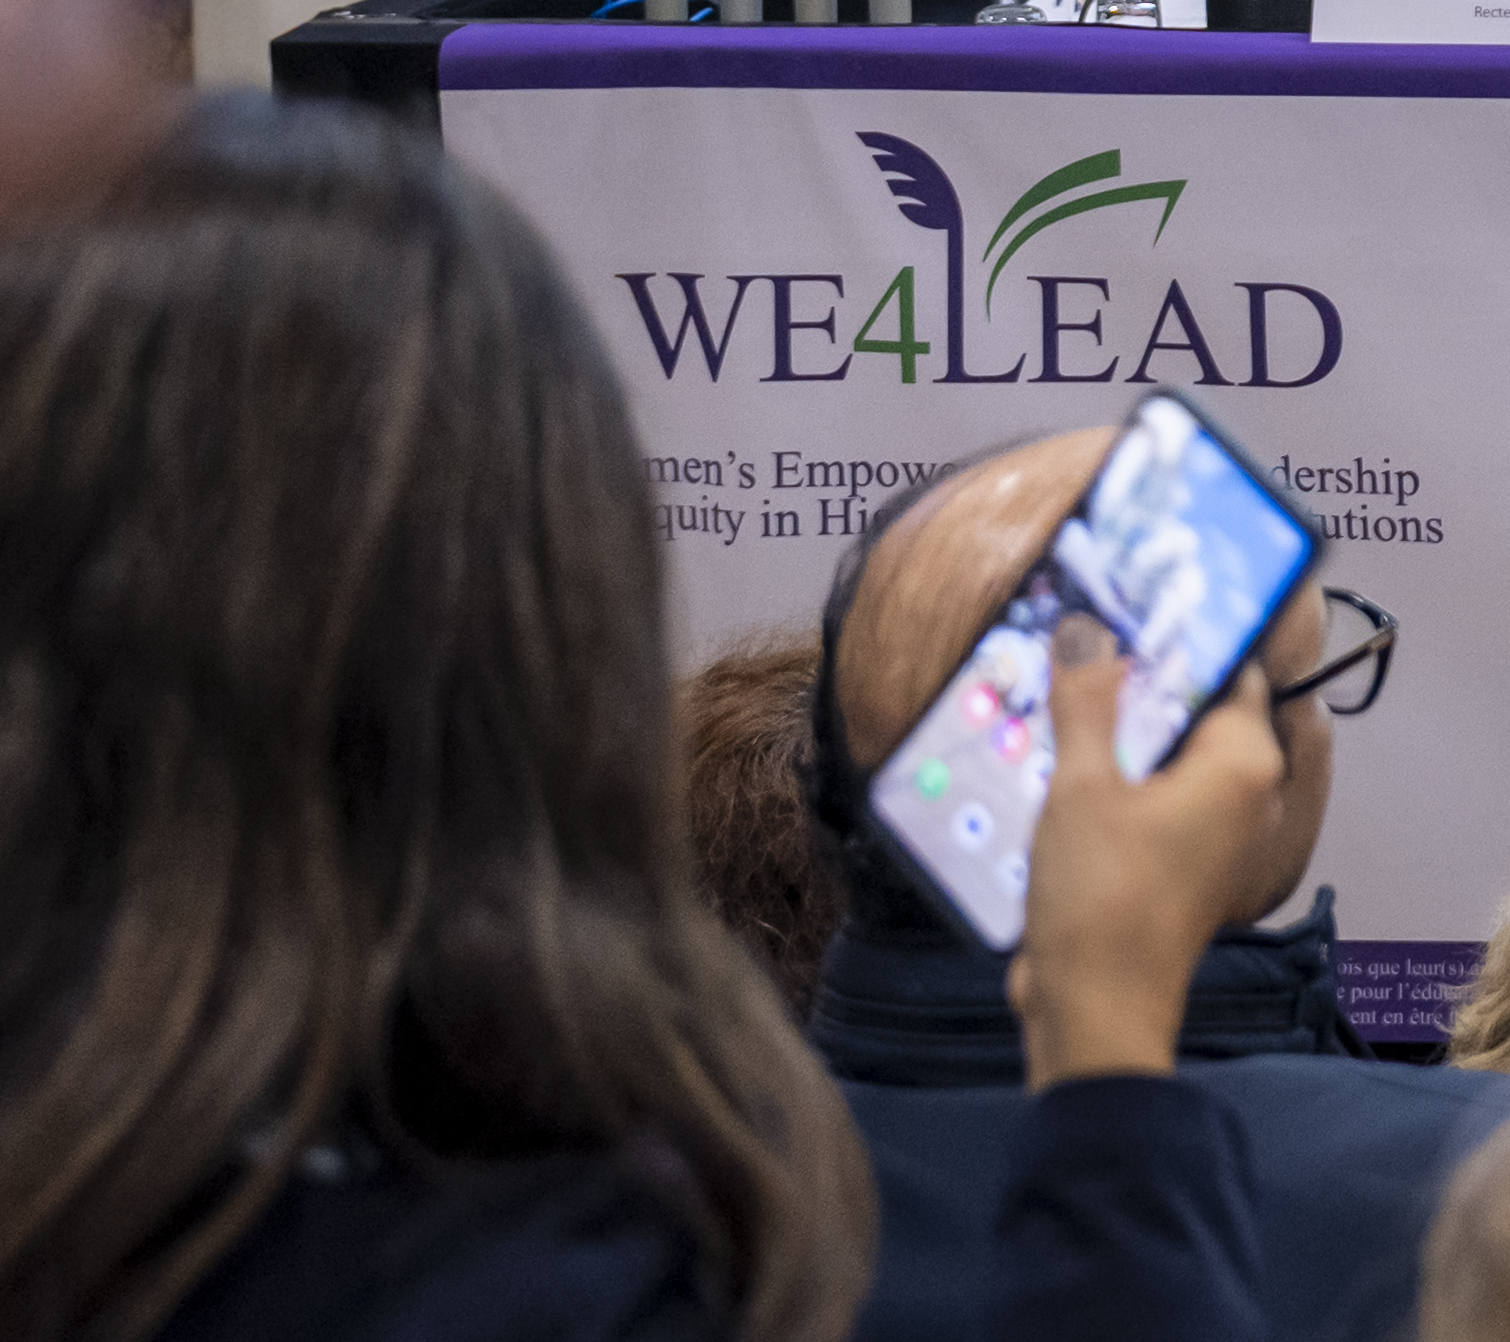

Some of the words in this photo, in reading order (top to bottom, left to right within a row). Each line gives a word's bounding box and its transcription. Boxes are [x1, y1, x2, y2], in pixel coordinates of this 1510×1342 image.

[615, 223, 1343, 388] WE4LEAD
[1368, 962, 1400, 979] que
[1407, 959, 1464, 976] leur(s)
[1351, 986, 1392, 1003] pour
[1383, 1011, 1403, 1025] en
[1409, 1008, 1443, 1025] être
